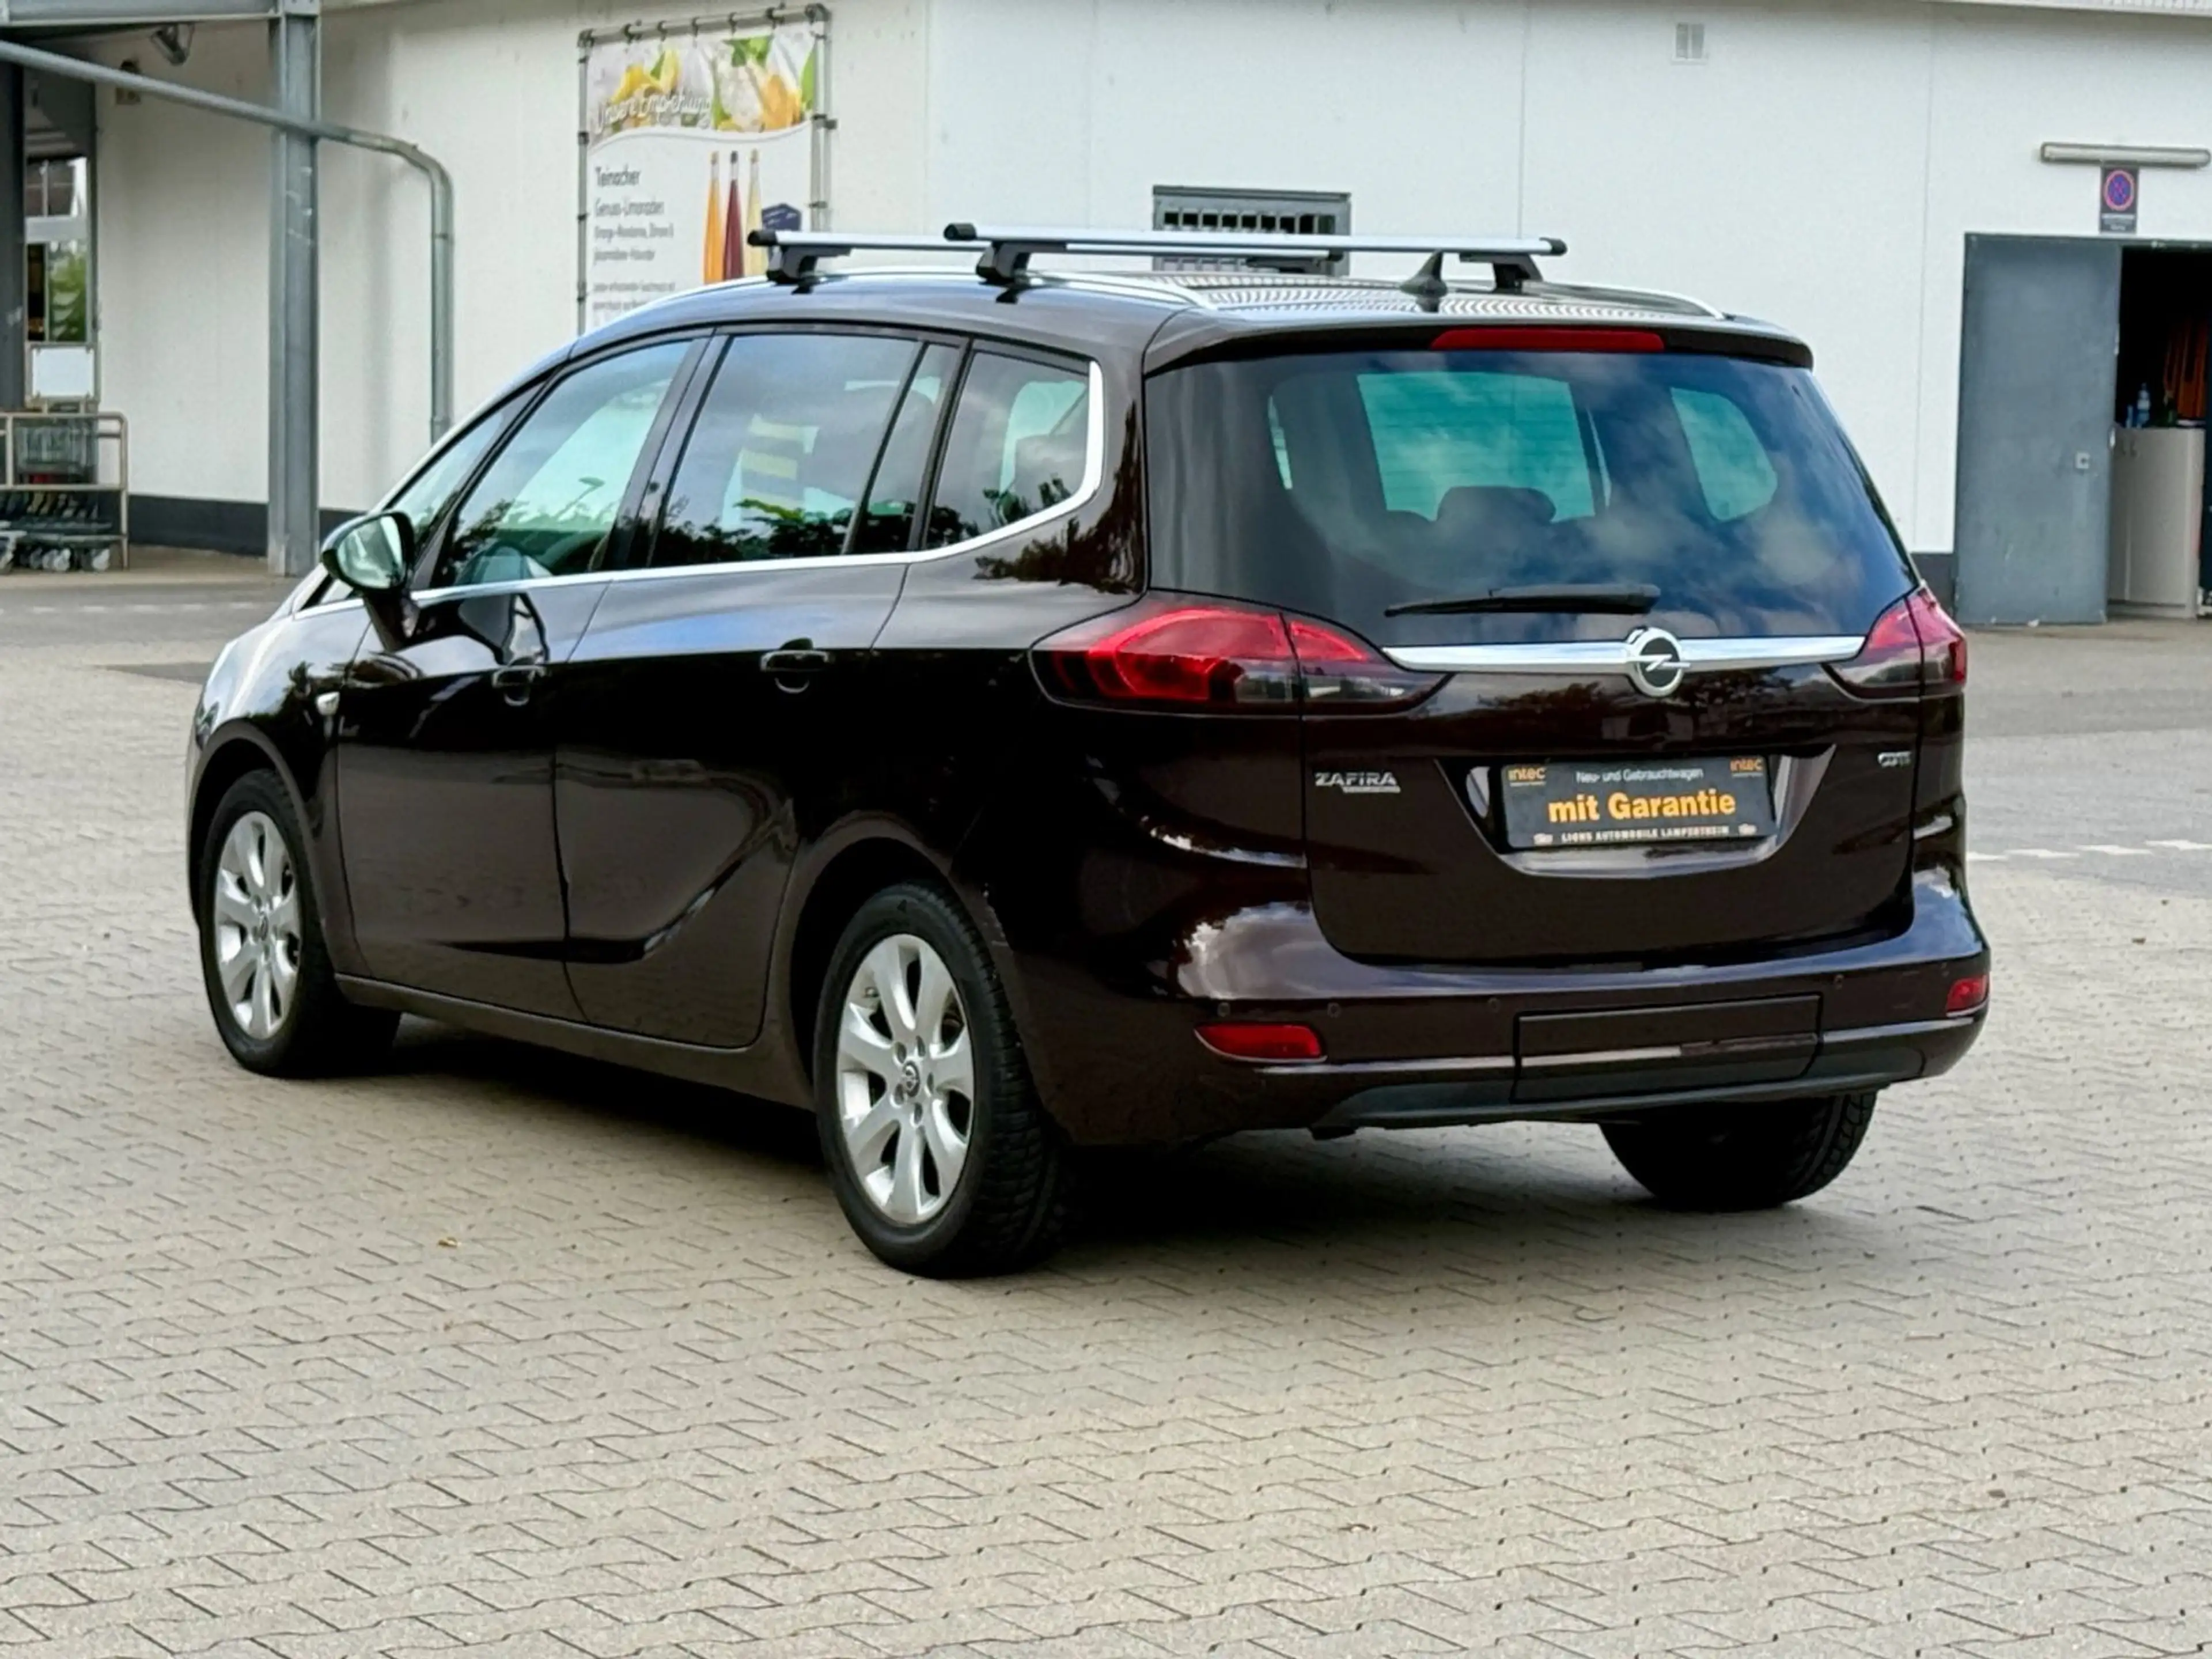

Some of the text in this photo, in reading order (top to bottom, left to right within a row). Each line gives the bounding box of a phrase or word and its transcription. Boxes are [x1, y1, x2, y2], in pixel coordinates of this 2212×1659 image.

[1315, 772, 1397, 786] ZAFIRA
[1602, 770, 1622, 782] und
[1623, 768, 1704, 781] Gebrauchtwagen
[1548, 788, 1736, 823] mit Garantie
[1595, 828, 1658, 842] AUTOMOBILE
